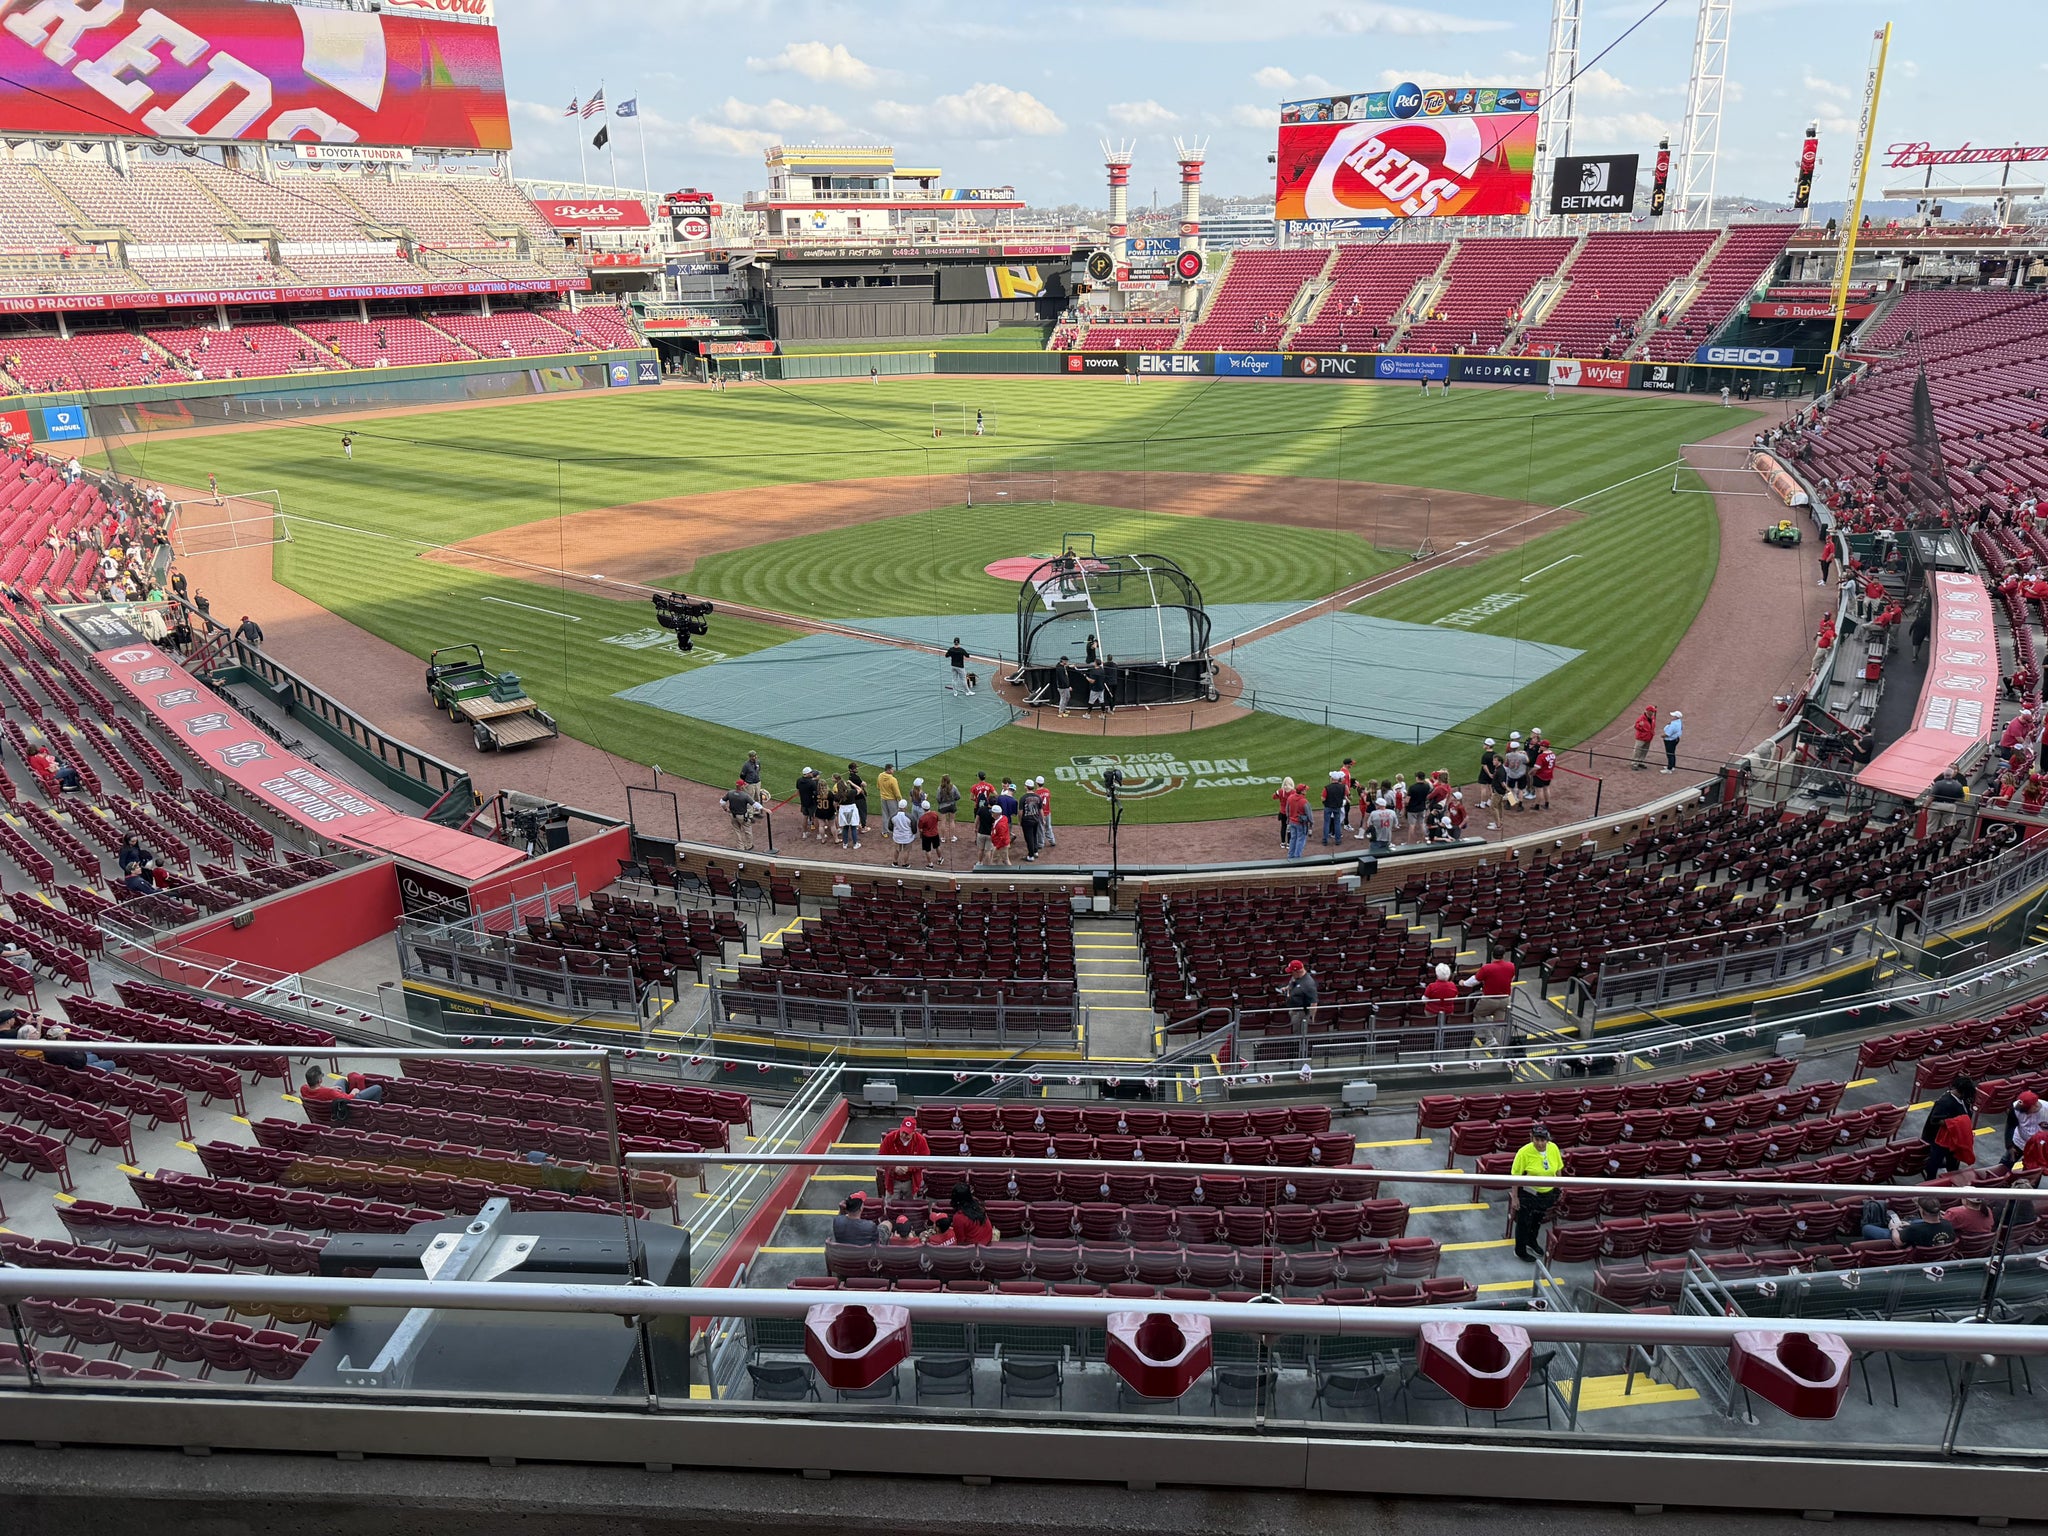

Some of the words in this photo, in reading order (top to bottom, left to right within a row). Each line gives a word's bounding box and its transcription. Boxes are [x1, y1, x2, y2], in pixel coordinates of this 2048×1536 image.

[1395, 94, 1420, 108] P&G
[1424, 96, 1445, 111] Tide
[320, 148, 361, 158] TOYOTA
[361, 149, 404, 160] TUNDRA
[1344, 136, 1461, 216] REDS
[978, 189, 1015, 200] TriHealth
[1561, 194, 1625, 209] BETMGM
[554, 204, 624, 220] Reds
[671, 206, 708, 215] TUNDRA
[685, 225, 709, 233] REDS
[1289, 219, 1331, 233] BEACON
[1146, 239, 1171, 250] PNC
[690, 263, 720, 271] XAVIER
[431, 282, 464, 292] encore
[468, 281, 507, 293] BATTING
[508, 280, 552, 291] PRACTICE
[557, 278, 586, 288] encore
[115, 292, 160, 304] encore
[165, 291, 218, 304] BATTING
[219, 289, 277, 303] PRACTICE
[285, 287, 323, 298] encore
[328, 286, 373, 298] BATTING
[374, 284, 425, 296] PRACTICE
[37, 296, 106, 310] PRACTICE
[1085, 359, 1119, 367] TOYOTA
[1707, 348, 1780, 365] GEICO
[1241, 356, 1270, 374] Kroger
[1320, 358, 1357, 374] PNC
[1464, 364, 1531, 377] MEDPACE
[1587, 366, 1625, 382] Wyler
[1643, 380, 1675, 390] BETMGM
[51, 424, 81, 433] FANDUEL
[224, 742, 262, 763] 1972
[1124, 752, 1176, 764] 2026
[1054, 761, 1190, 782] OPENING
[1187, 758, 1250, 775] DAY
[1193, 775, 1283, 789] Adobe
[283, 767, 338, 796] NATIONAL
[325, 790, 377, 817] LEAGUE
[259, 777, 346, 823] CHAMPIONS
[816, 799, 829, 810] 30
[1380, 819, 1391, 829] 14
[419, 886, 468, 913] LEXUS
